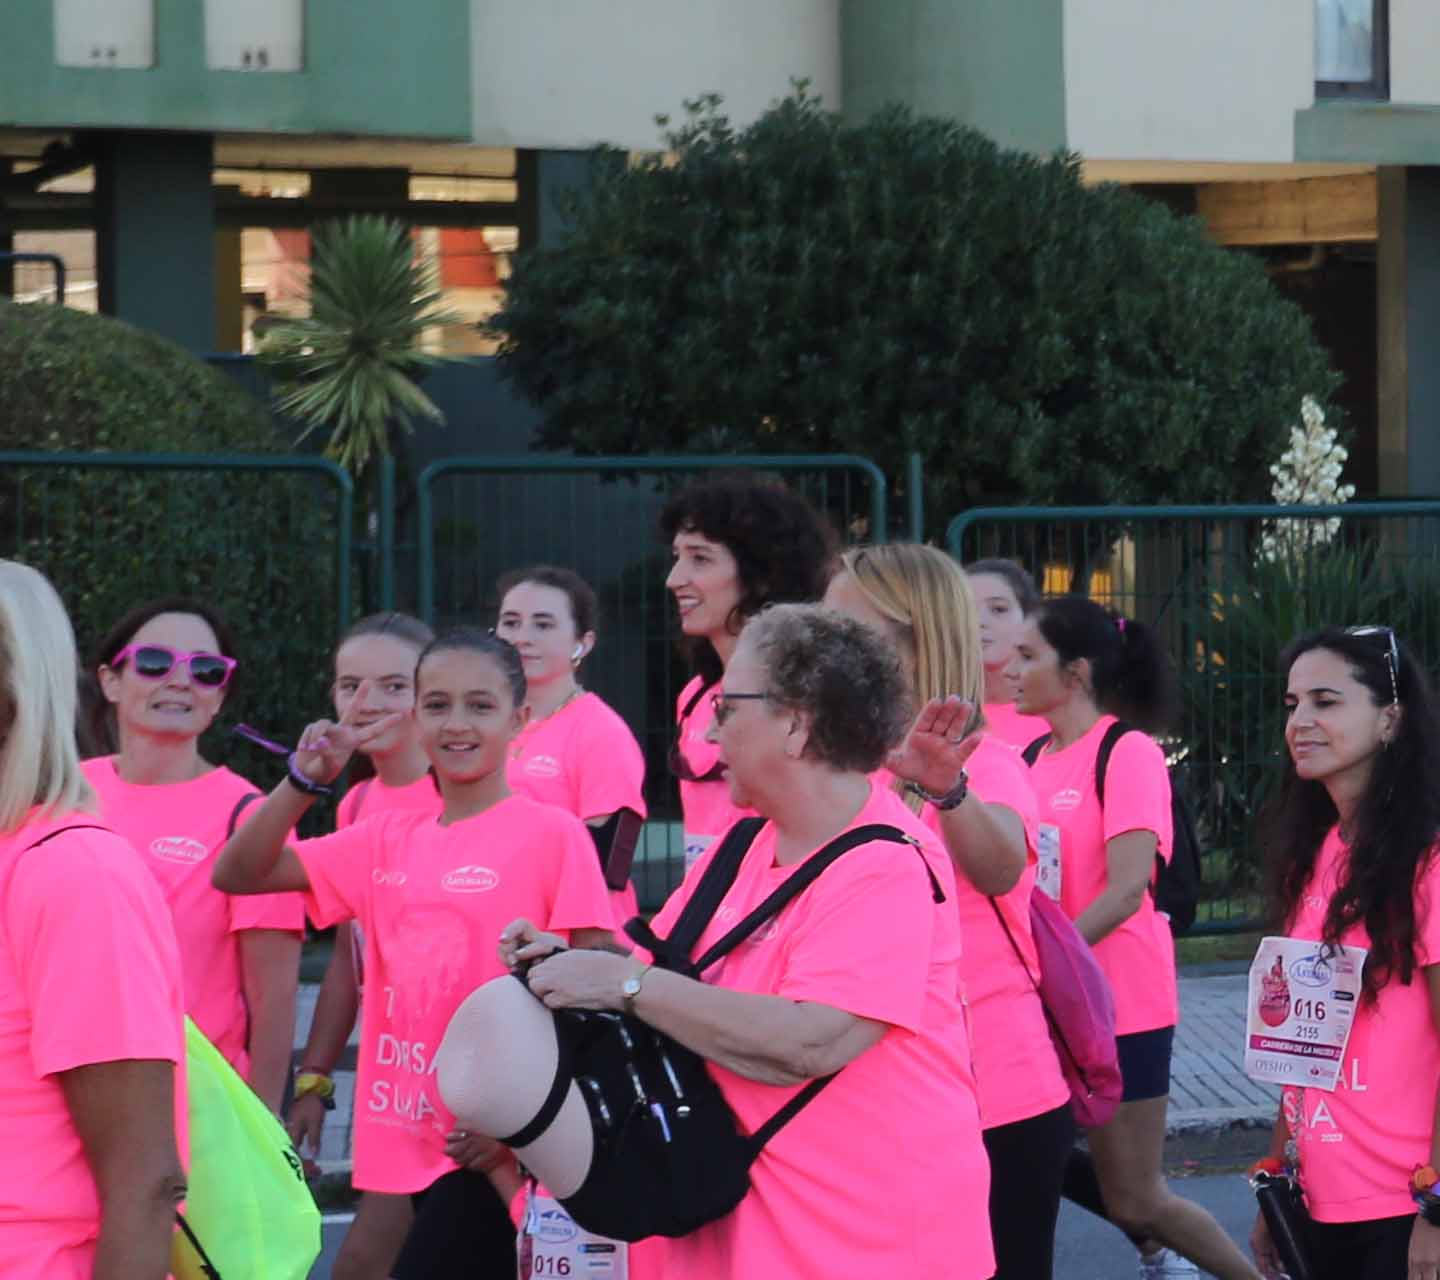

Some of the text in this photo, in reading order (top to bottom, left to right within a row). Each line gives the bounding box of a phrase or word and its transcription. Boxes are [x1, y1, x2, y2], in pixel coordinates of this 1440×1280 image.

[1295, 998, 1326, 1021] 016
[1296, 1024, 1320, 1039] 2155
[535, 1255, 571, 1276] 016
